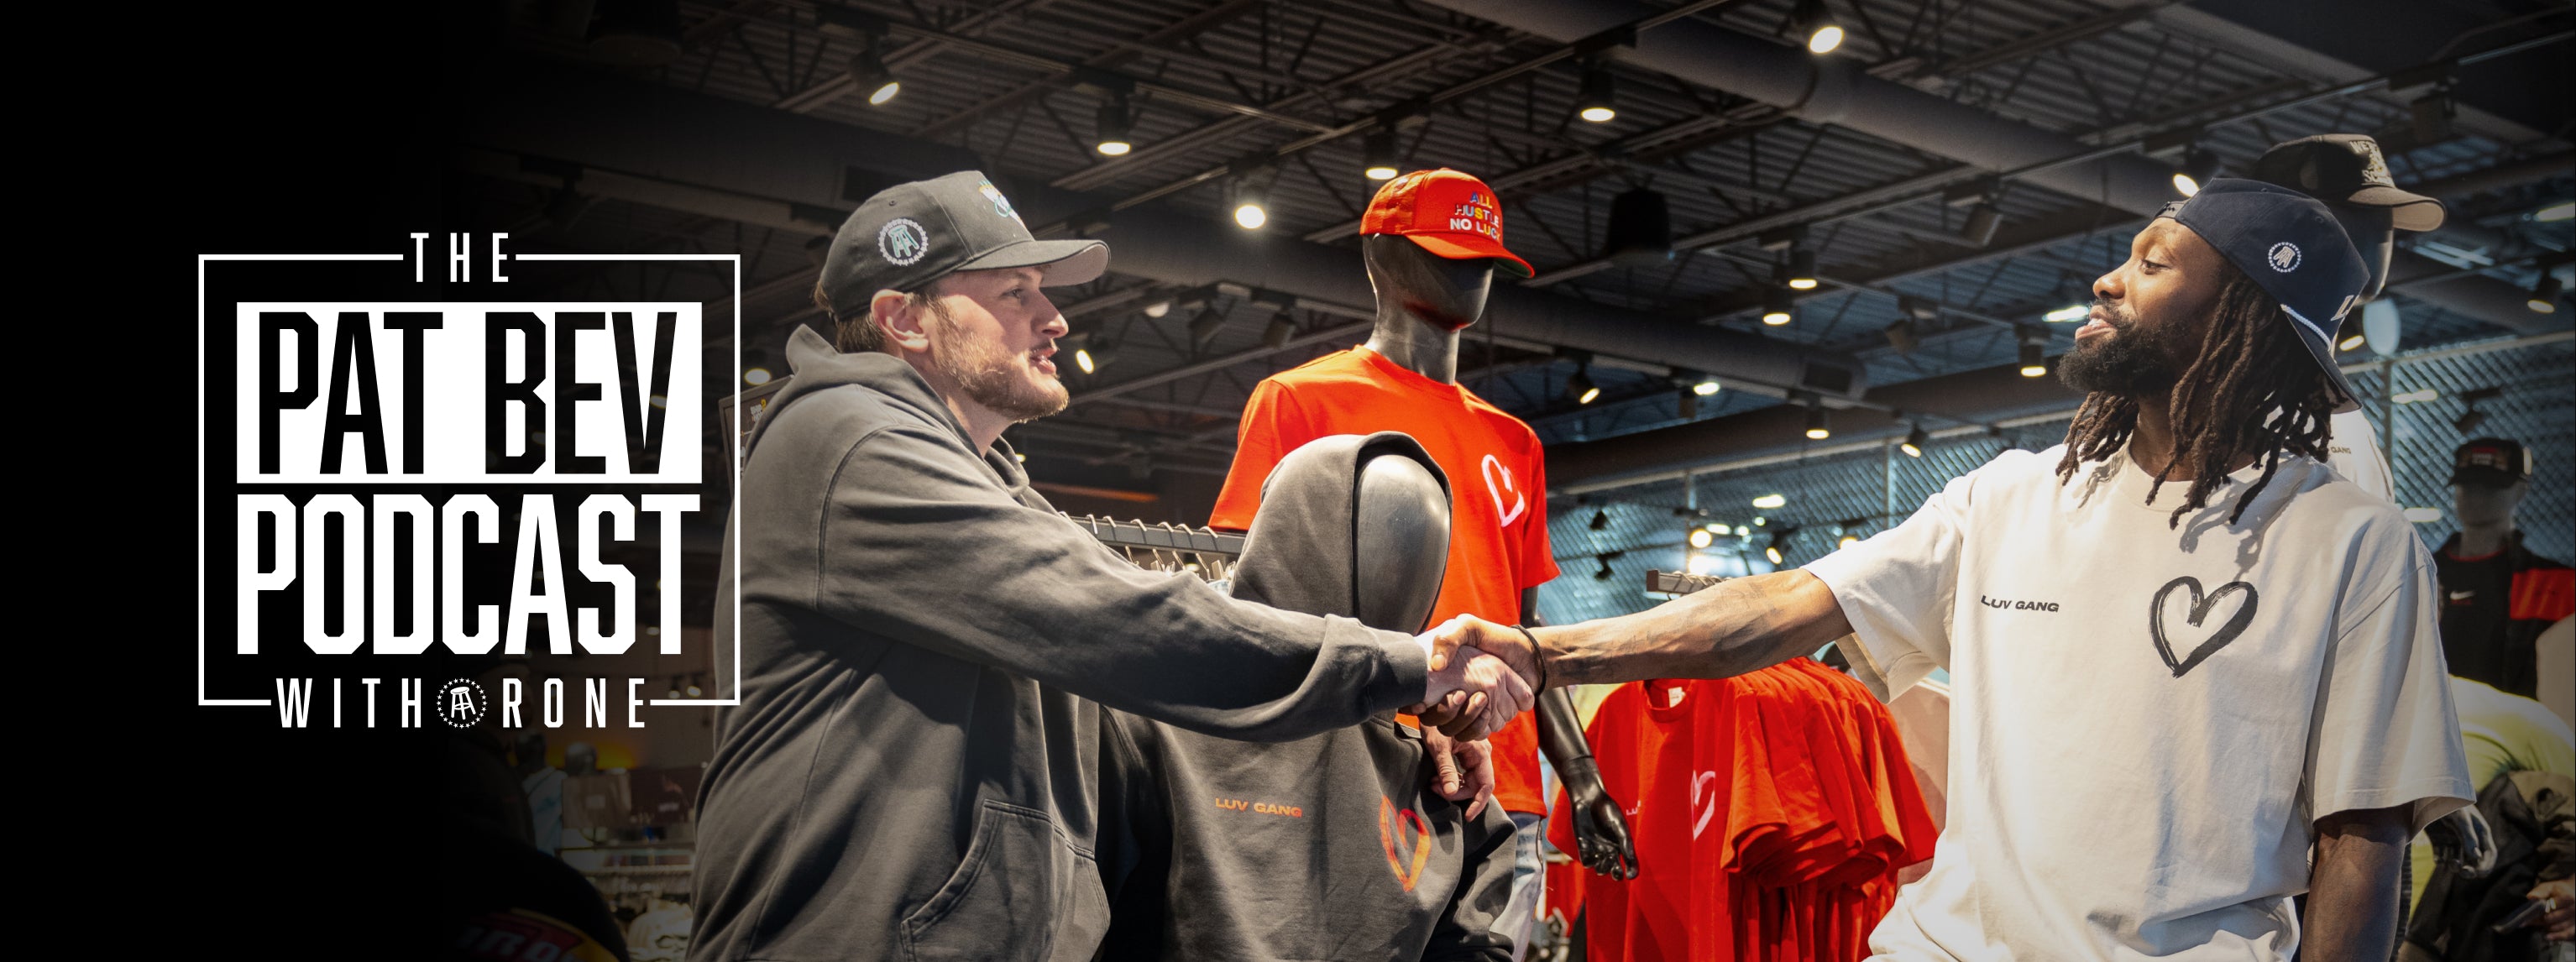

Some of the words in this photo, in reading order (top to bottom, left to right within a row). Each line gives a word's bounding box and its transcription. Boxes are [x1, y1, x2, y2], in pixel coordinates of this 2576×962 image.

[1469, 191, 1493, 209] ALL
[1449, 217, 1473, 231] NO
[1454, 204, 1500, 228] HUSTLE
[1981, 594, 2012, 609] LUV
[2014, 600, 2060, 613] GANG
[1215, 797, 1249, 813] LUV
[1254, 802, 1302, 818] GANG
